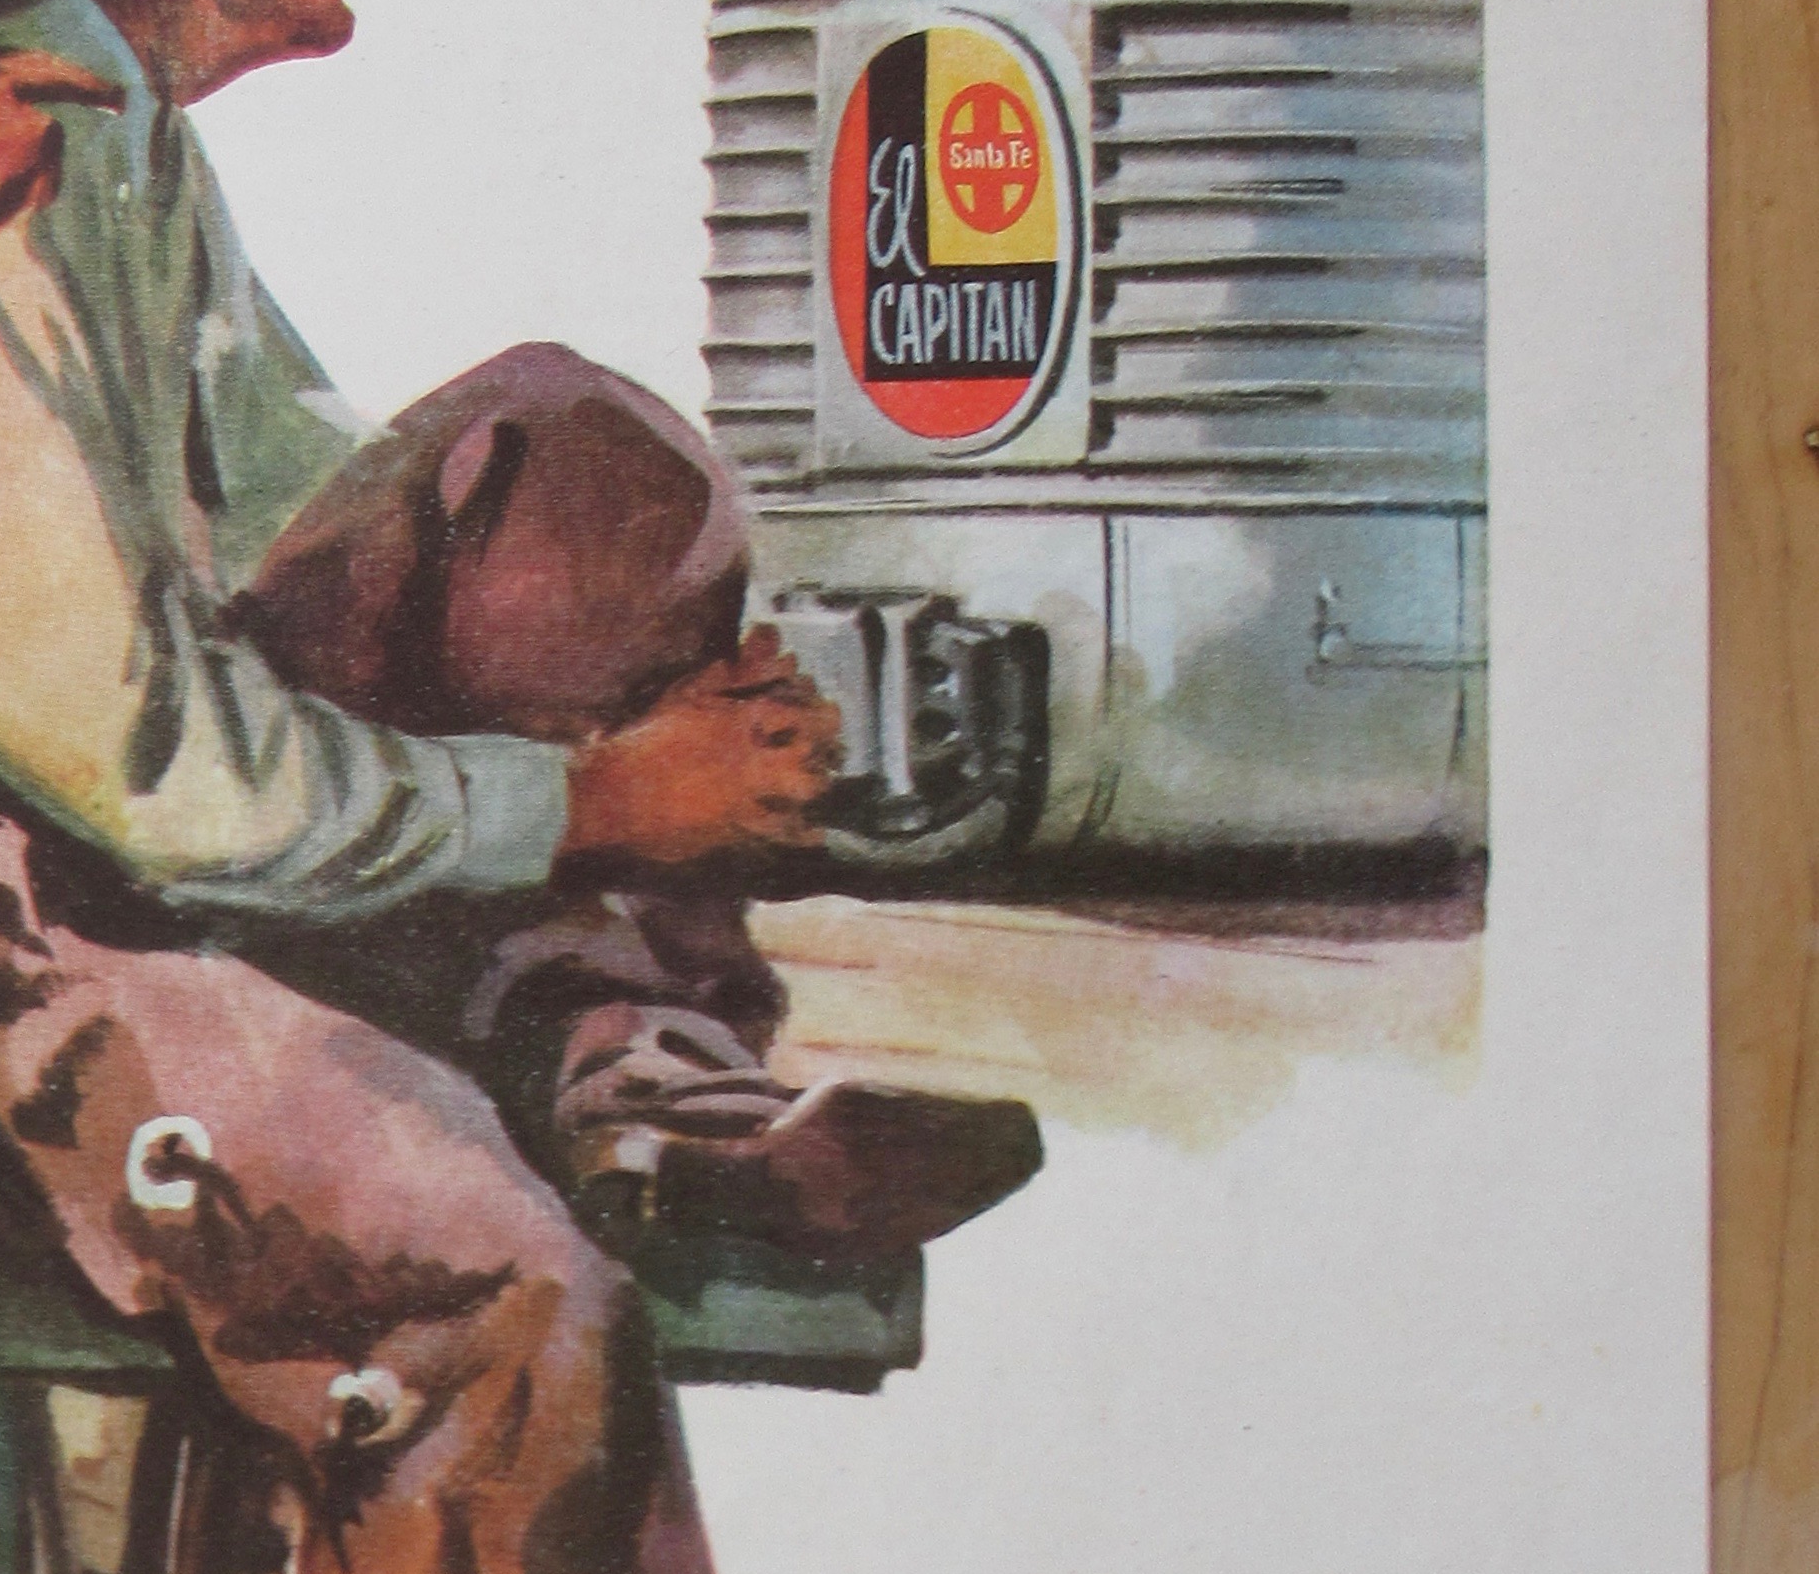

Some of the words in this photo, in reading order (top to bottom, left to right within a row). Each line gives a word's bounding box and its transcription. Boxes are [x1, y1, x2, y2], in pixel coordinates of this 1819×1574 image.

[949, 142, 1007, 170] Santa
[1009, 142, 1033, 170] Fe
[868, 137, 928, 278] El
[870, 279, 1038, 366] CAPITAN
